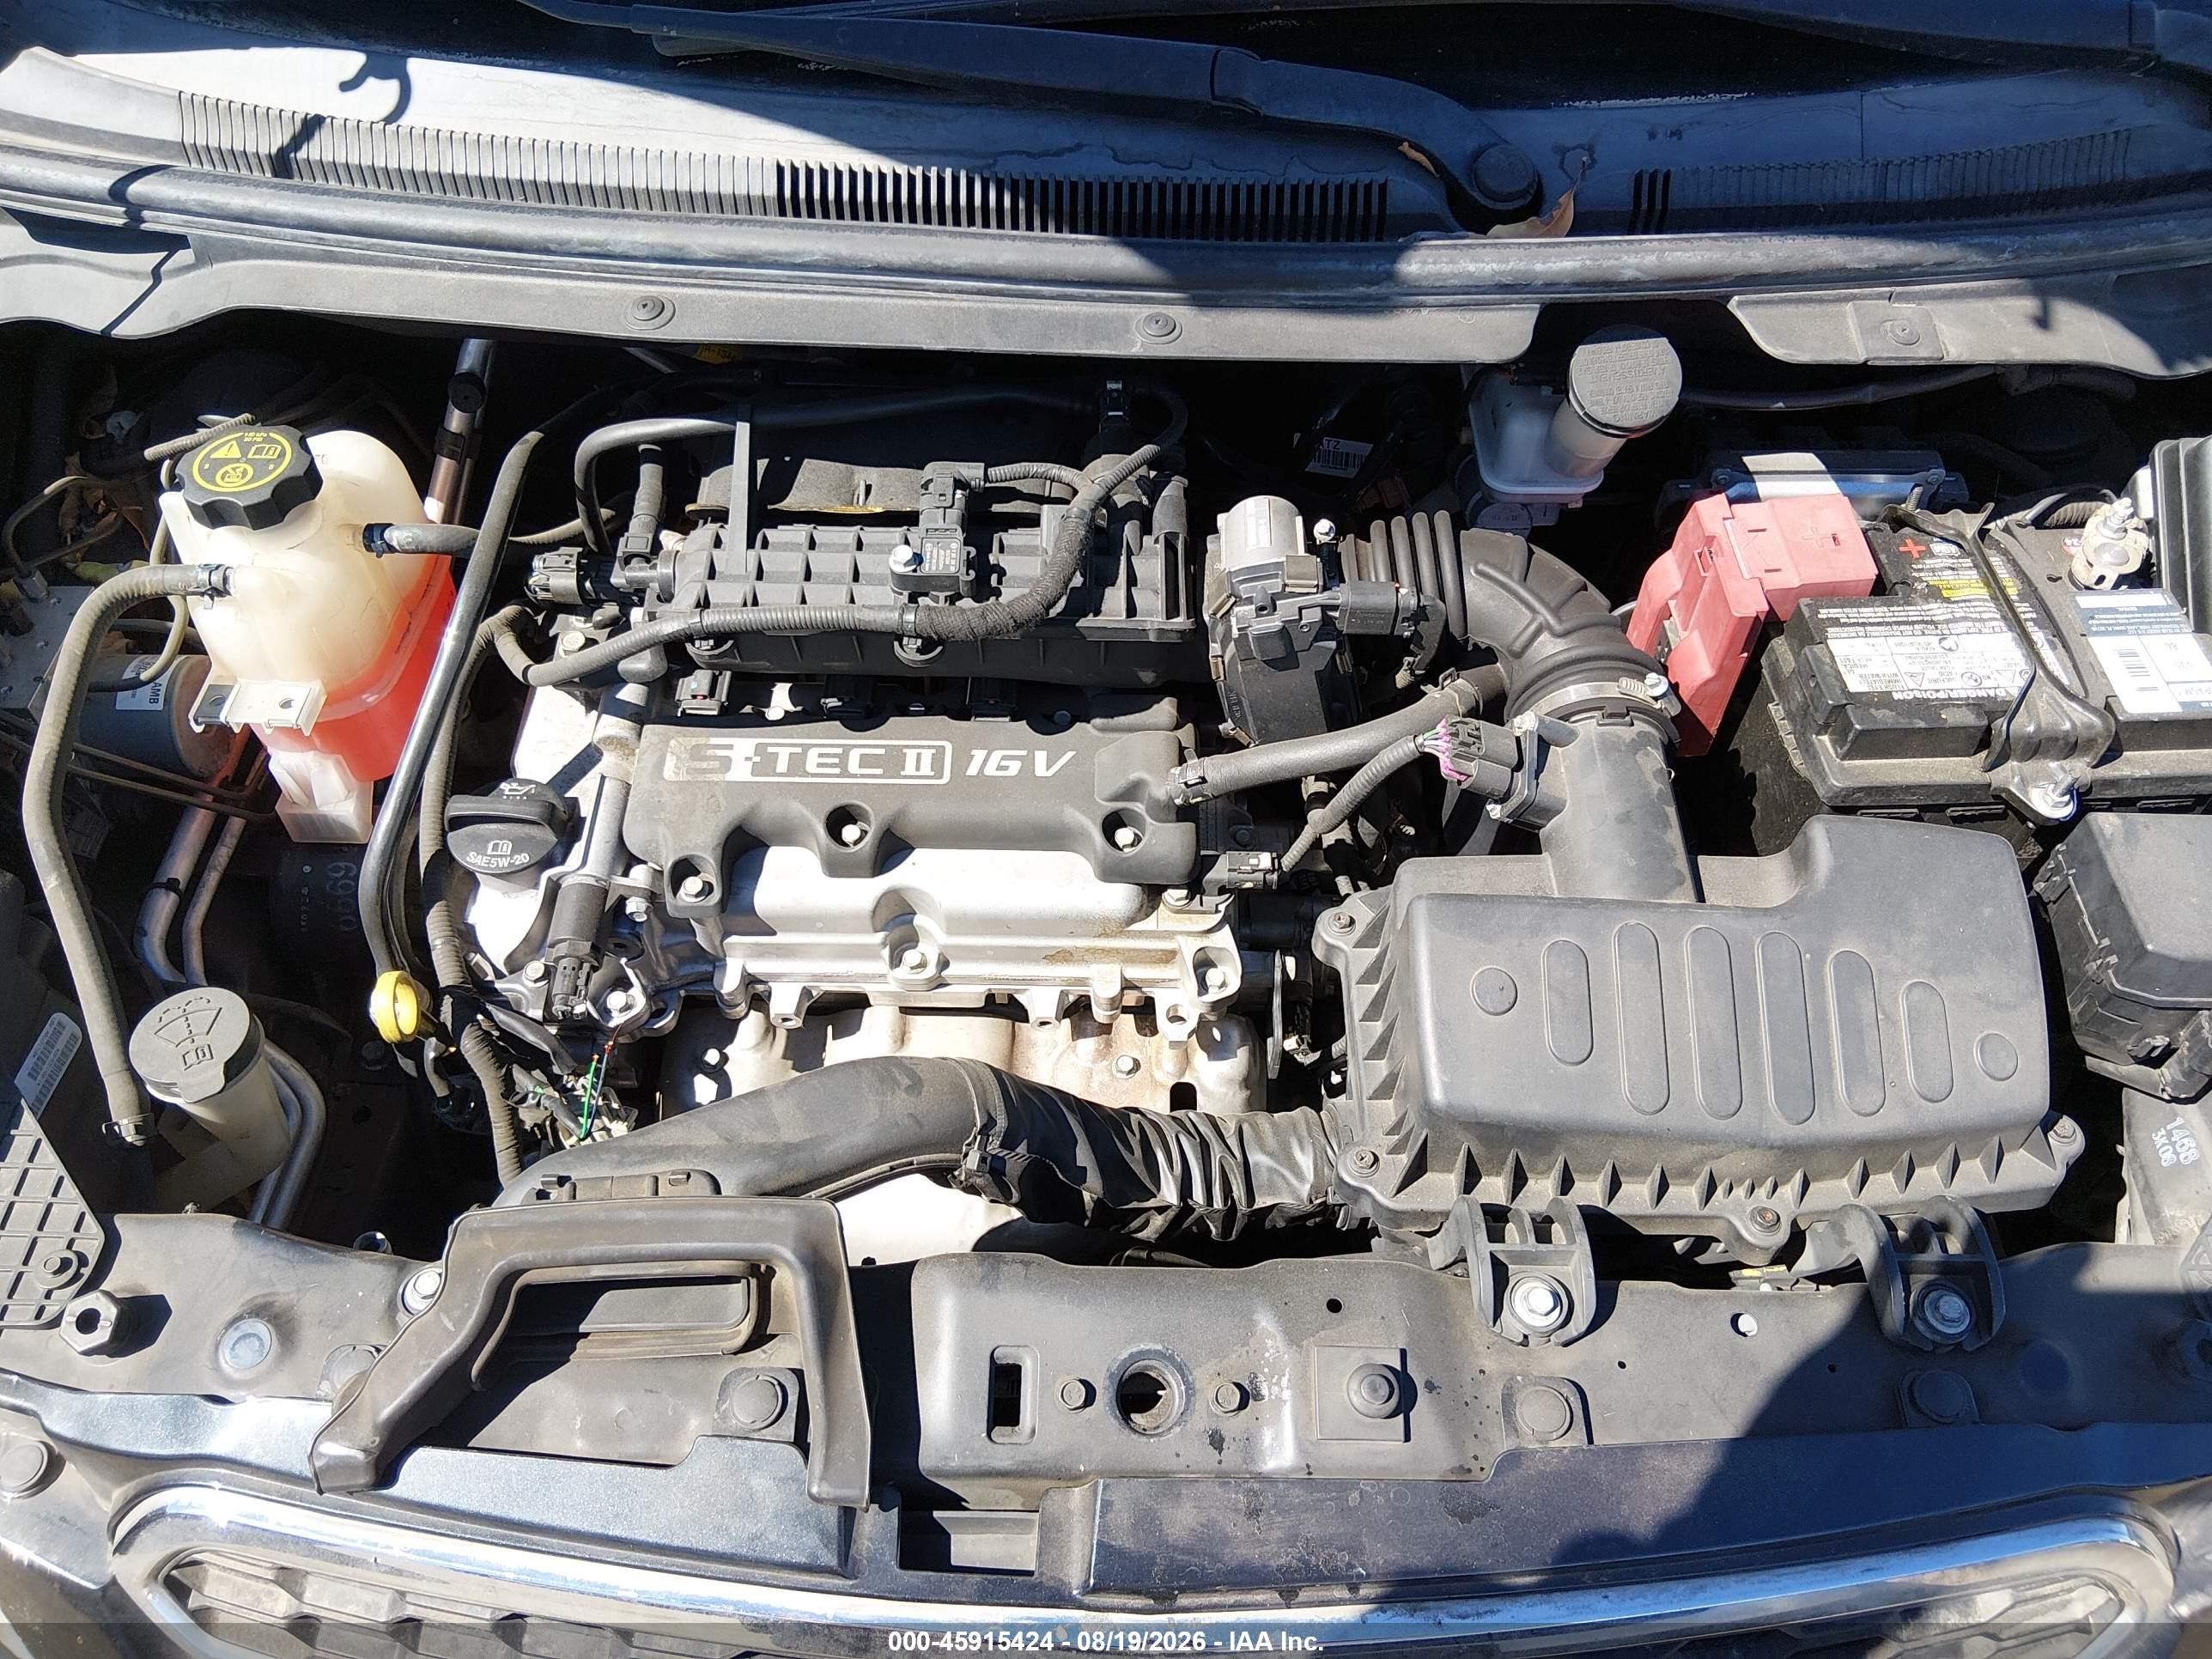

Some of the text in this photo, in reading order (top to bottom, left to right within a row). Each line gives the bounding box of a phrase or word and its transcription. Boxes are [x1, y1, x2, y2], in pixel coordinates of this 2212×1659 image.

[149, 683, 162, 704] AMB
[1892, 689, 2007, 700] DANGER/POISON
[683, 744, 887, 777] S-TEC
[901, 748, 936, 776] II
[466, 852, 530, 868] SAE5W-20
[2151, 1127, 2177, 1168] 3K08
[2166, 1116, 2200, 1165] 1468
